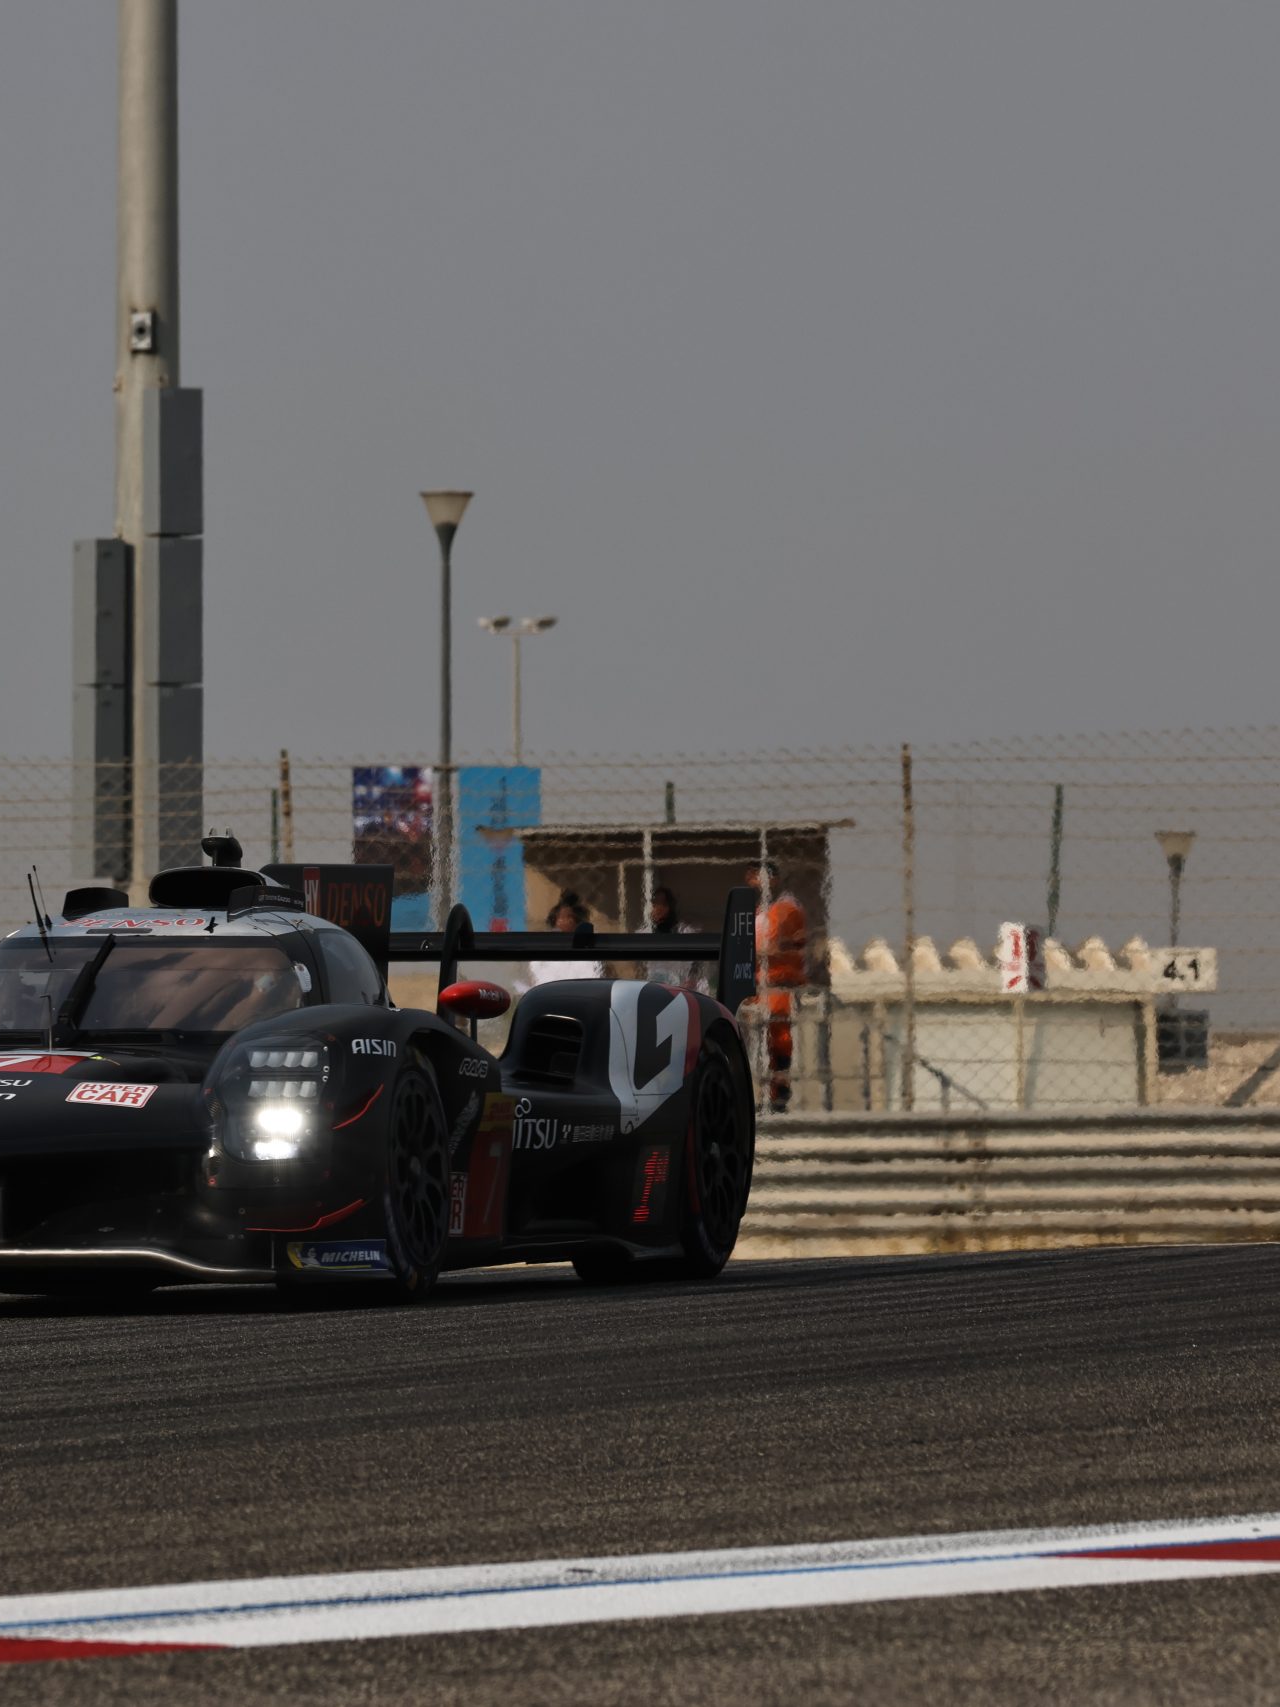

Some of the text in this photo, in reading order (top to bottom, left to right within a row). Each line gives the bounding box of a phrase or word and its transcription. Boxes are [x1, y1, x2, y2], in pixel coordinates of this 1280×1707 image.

[327, 882, 387, 928] DENSO
[730, 912, 754, 937] JFE
[351, 1038, 397, 1058] AISIN
[82, 1083, 149, 1093] HYPER
[76, 1090, 143, 1105] CAR
[321, 1250, 381, 1263] MICHELIN
